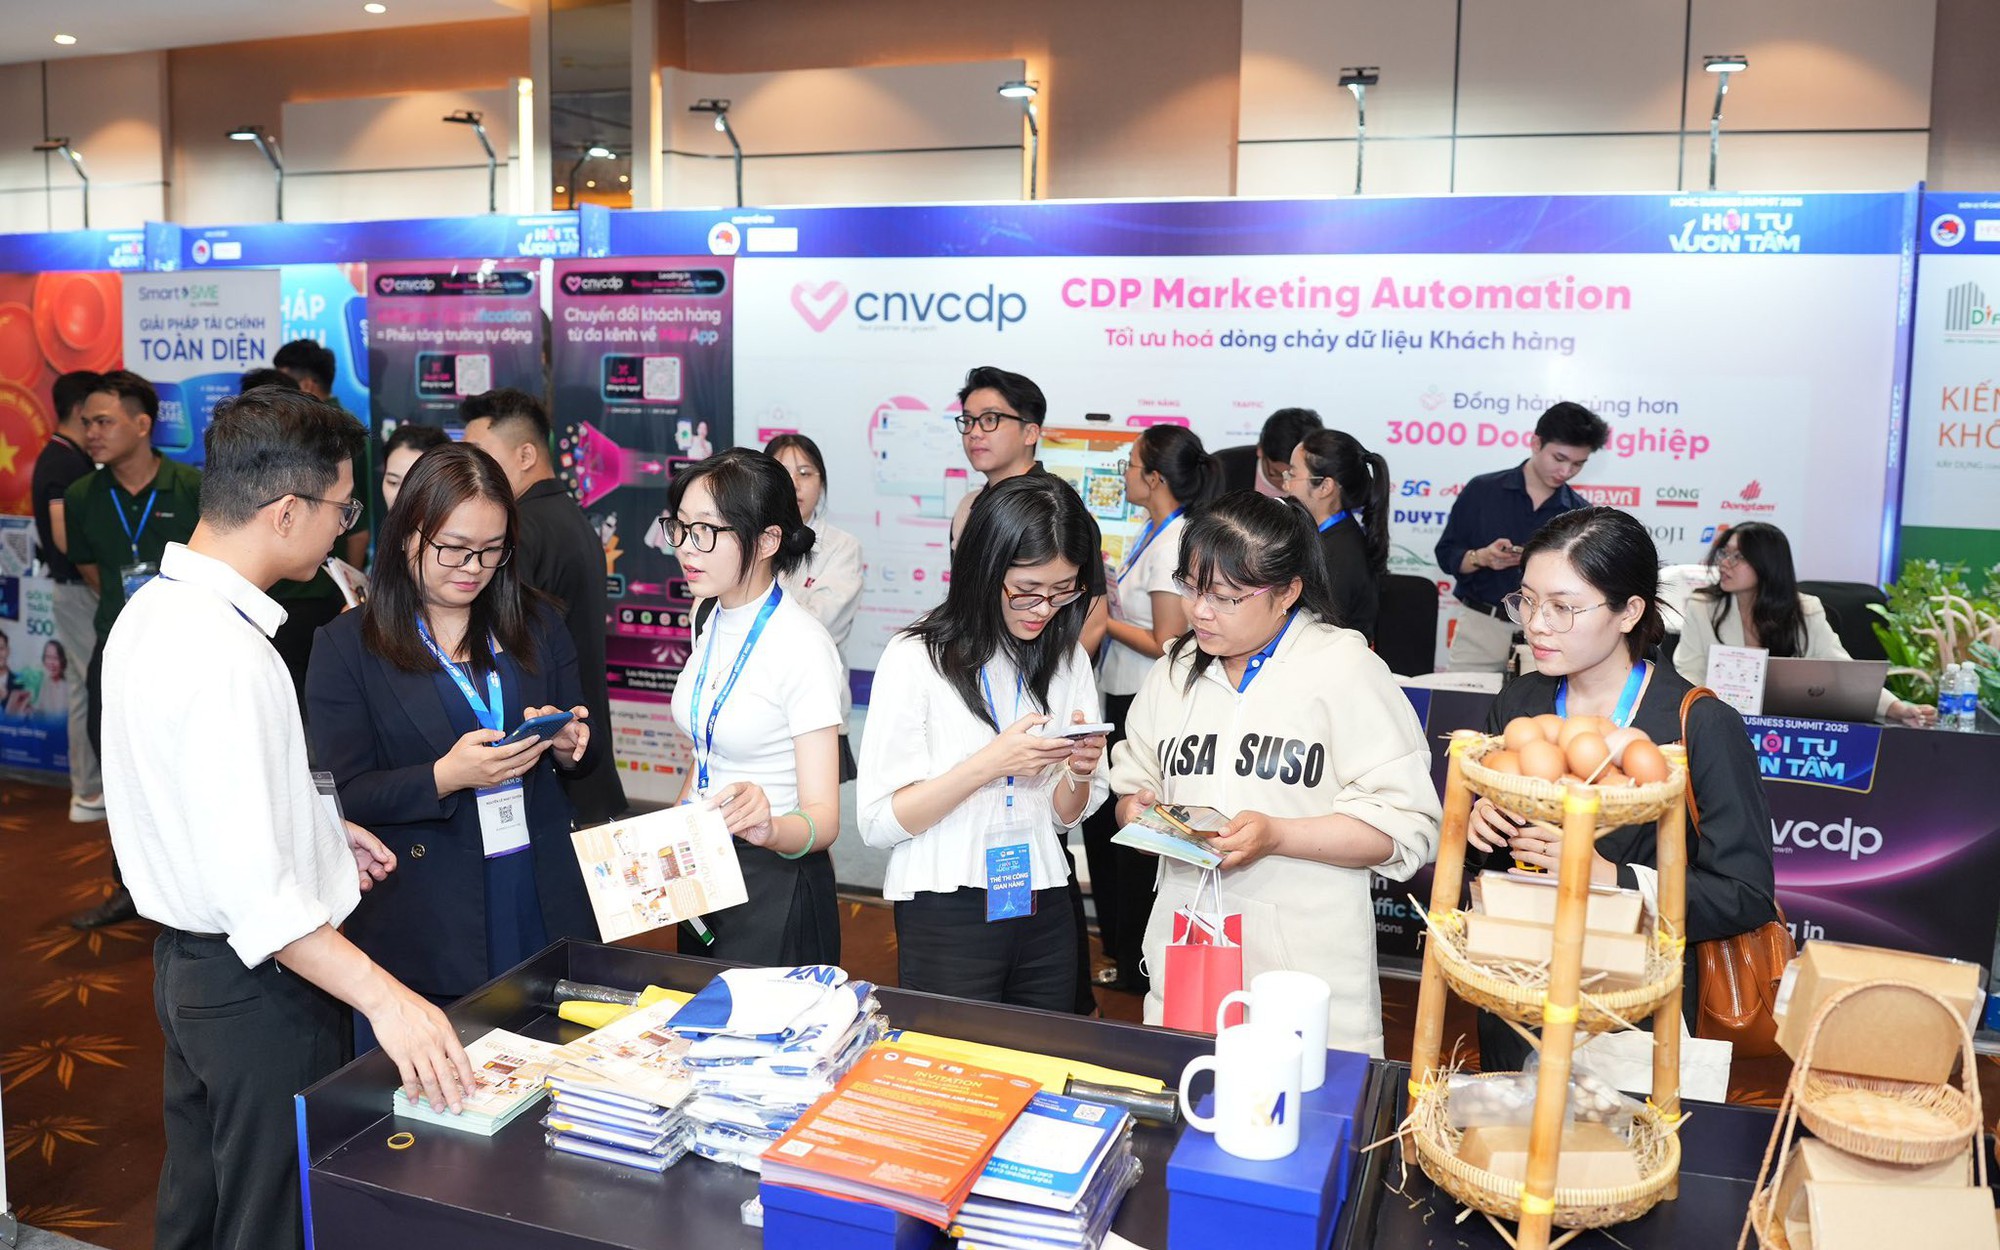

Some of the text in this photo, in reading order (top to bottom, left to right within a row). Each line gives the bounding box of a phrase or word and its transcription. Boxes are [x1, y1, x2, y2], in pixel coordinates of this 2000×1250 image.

[139, 286, 179, 301] Smart
[1061, 275, 1632, 318] CDP Marketing Automation
[855, 283, 1027, 331] cnvcdp
[689, 329, 719, 346] App
[1105, 326, 1576, 356] Tối ưu hoá dòng chảy dữ liệu Khách hàng
[140, 332, 265, 367] TOÀN DIỆN
[1637, 396, 1679, 414] hơn
[1386, 421, 1468, 446] 3000
[1400, 480, 1432, 497] 5G
[1656, 486, 1699, 500] CÔNG
[1742, 716, 1850, 733] USINESS SUMMIT 2025
[1797, 736, 1838, 761] TỤ
[1235, 733, 1325, 788] SUSO
[913, 1070, 984, 1089] INVITATION
